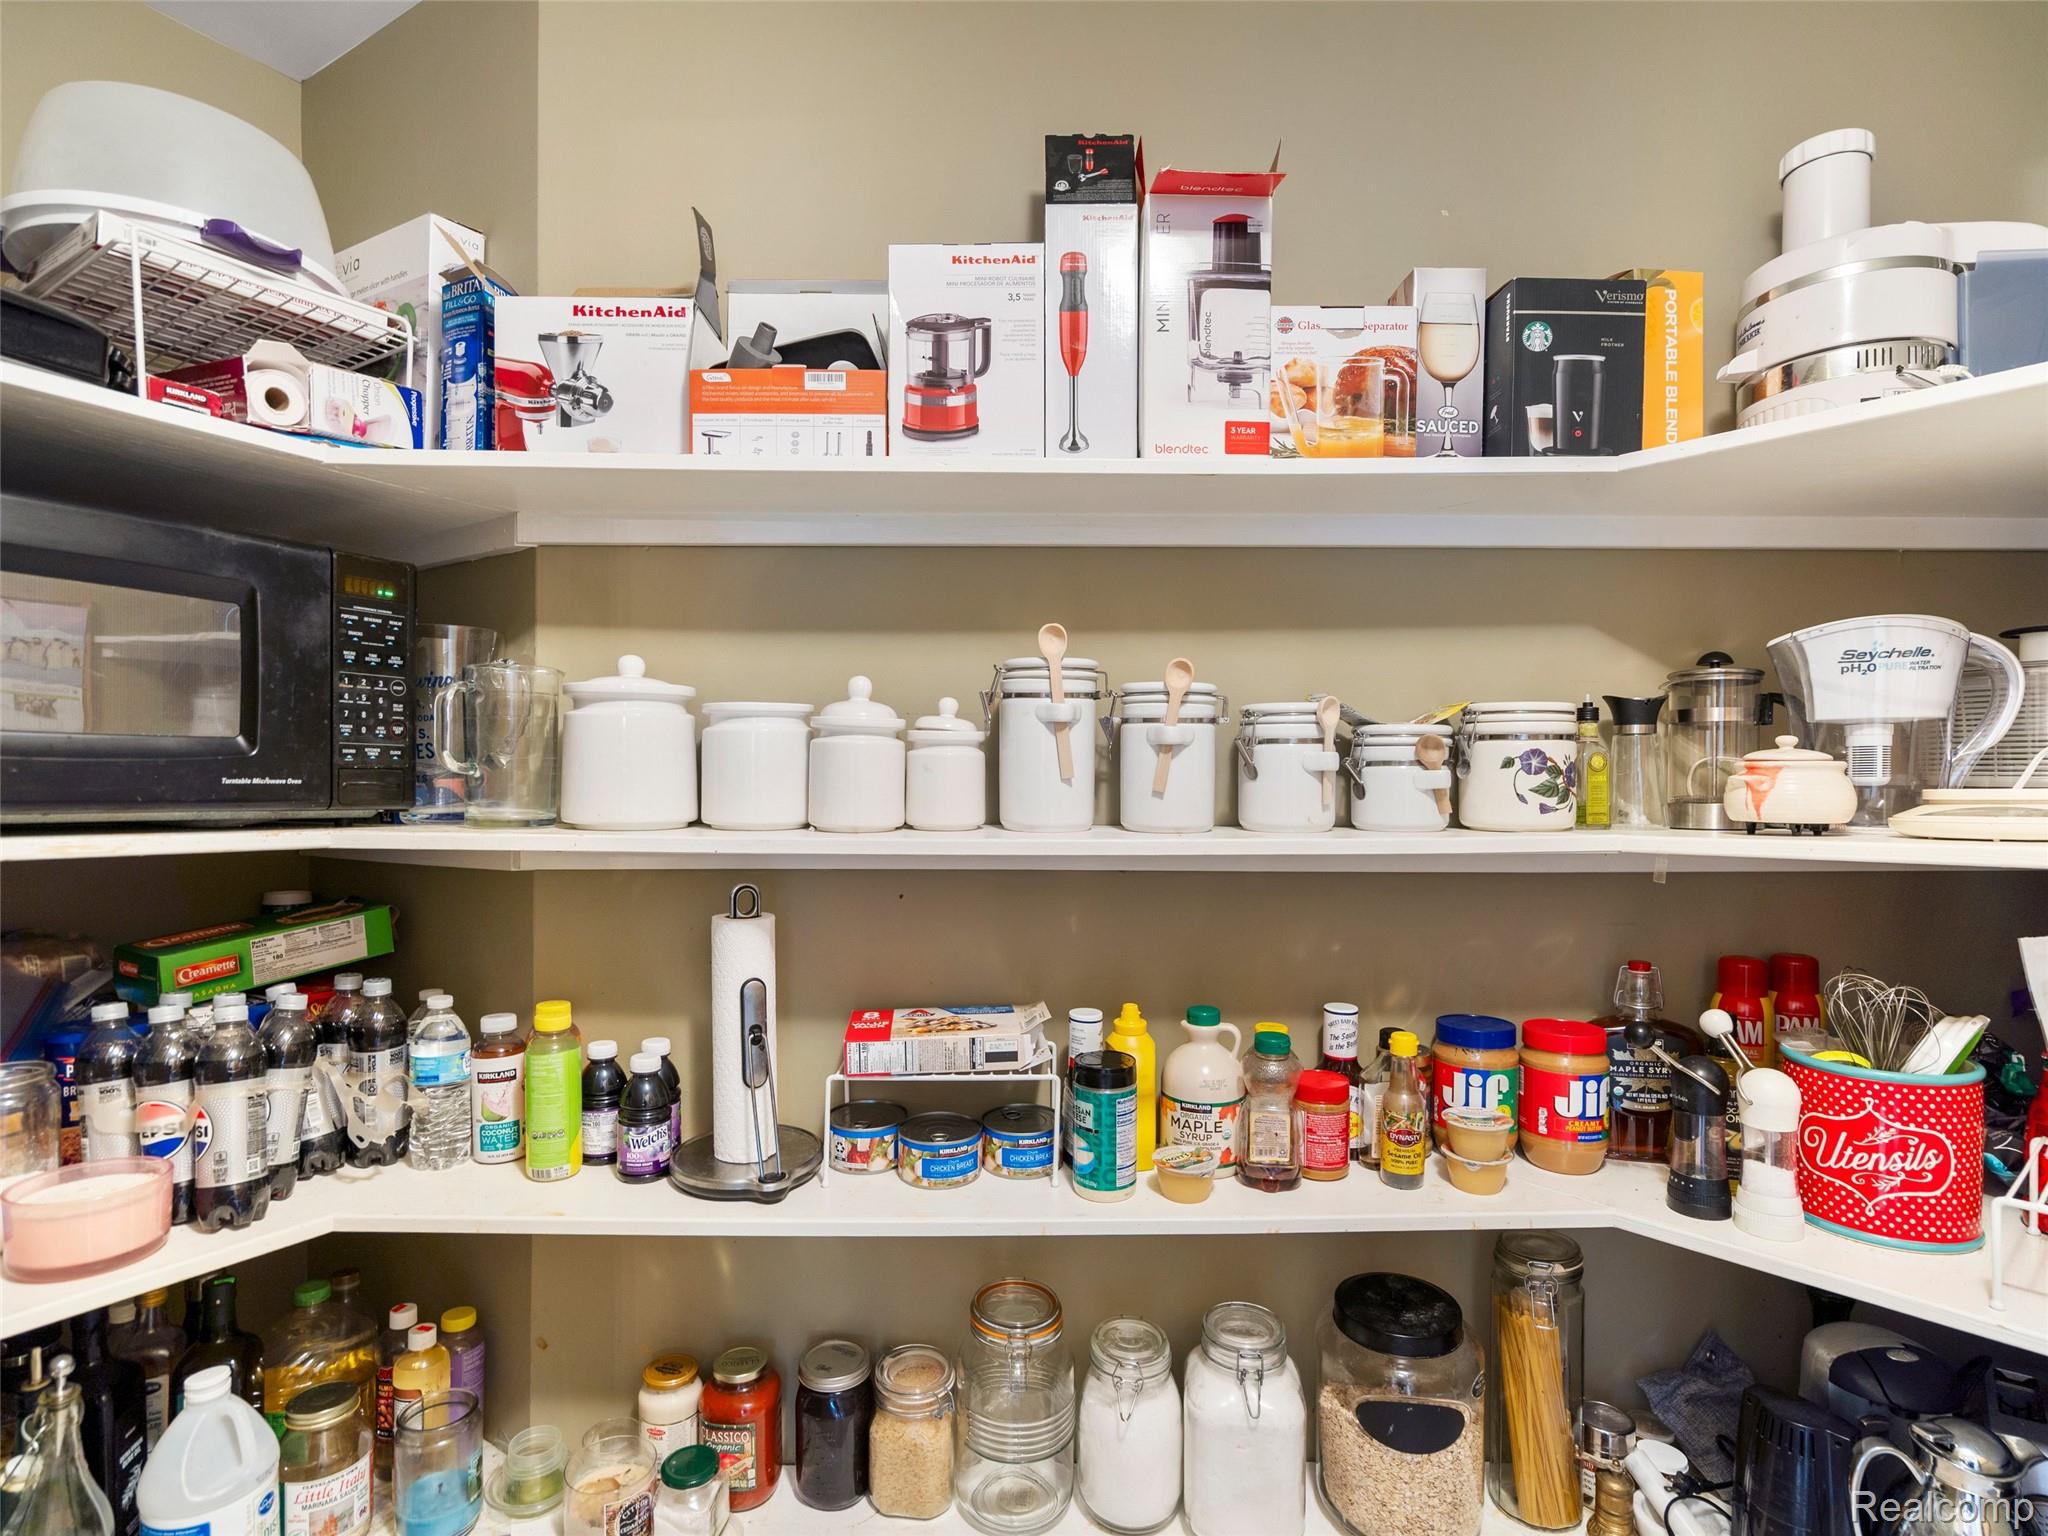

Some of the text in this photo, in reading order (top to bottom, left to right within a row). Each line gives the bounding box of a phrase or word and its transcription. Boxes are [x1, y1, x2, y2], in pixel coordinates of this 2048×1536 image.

[1180, 184, 1244, 193] blendtec
[342, 255, 361, 276] via
[952, 254, 1037, 266] KitchenAid
[451, 278, 482, 298] BRITA
[1007, 292, 1021, 302] 3,5
[1594, 289, 1645, 303] Verismo
[572, 304, 686, 318] KitchenAid
[1297, 320, 1321, 330] Glas
[1363, 321, 1409, 333] Separator
[1664, 288, 1679, 383] PORTABLE
[166, 386, 207, 403] KIRKLAND
[361, 379, 371, 416] Chopper
[1237, 427, 1256, 435] YEAR
[1416, 419, 1479, 434] SAUCED
[1154, 443, 1209, 455] blendtec
[1840, 646, 1932, 663] Seychelle
[221, 777, 251, 785] Turntable
[252, 777, 287, 785] Microwave
[177, 958, 237, 983] Creamette
[193, 982, 237, 998] ASAGNA
[1775, 1013, 1820, 1032] PAM
[1329, 1033, 1340, 1041] The
[1735, 1020, 1763, 1045] AM
[478, 1069, 516, 1080] KIRKLAND
[1609, 1065, 1672, 1074] MAPLE SYR
[1442, 1071, 1510, 1109] Jif
[1554, 1075, 1610, 1118] Jif
[1181, 1102, 1211, 1110] KIRKLAND
[1180, 1111, 1212, 1120] ORGANIC
[481, 1126, 518, 1136] COCONUT
[1170, 1115, 1223, 1134] MAPLE
[481, 1132, 519, 1144] WATER
[630, 1126, 667, 1150] Welch's
[1018, 1137, 1047, 1145] KIRKLAND
[1179, 1130, 1213, 1142] SYRUP
[1389, 1131, 1420, 1142] DYNASTY
[939, 1145, 968, 1155] KIRKLAND
[1387, 1149, 1412, 1159] Sesame
[1803, 1125, 1944, 1173] Utensils
[1009, 1154, 1034, 1162] CHICKEN
[930, 1163, 956, 1172] CHICKEN
[702, 1426, 750, 1443] CLASSICO
[706, 1441, 742, 1453] Organic
[293, 1469, 366, 1505] Little Italy
[301, 1486, 359, 1511] MARINARA SAUCE
